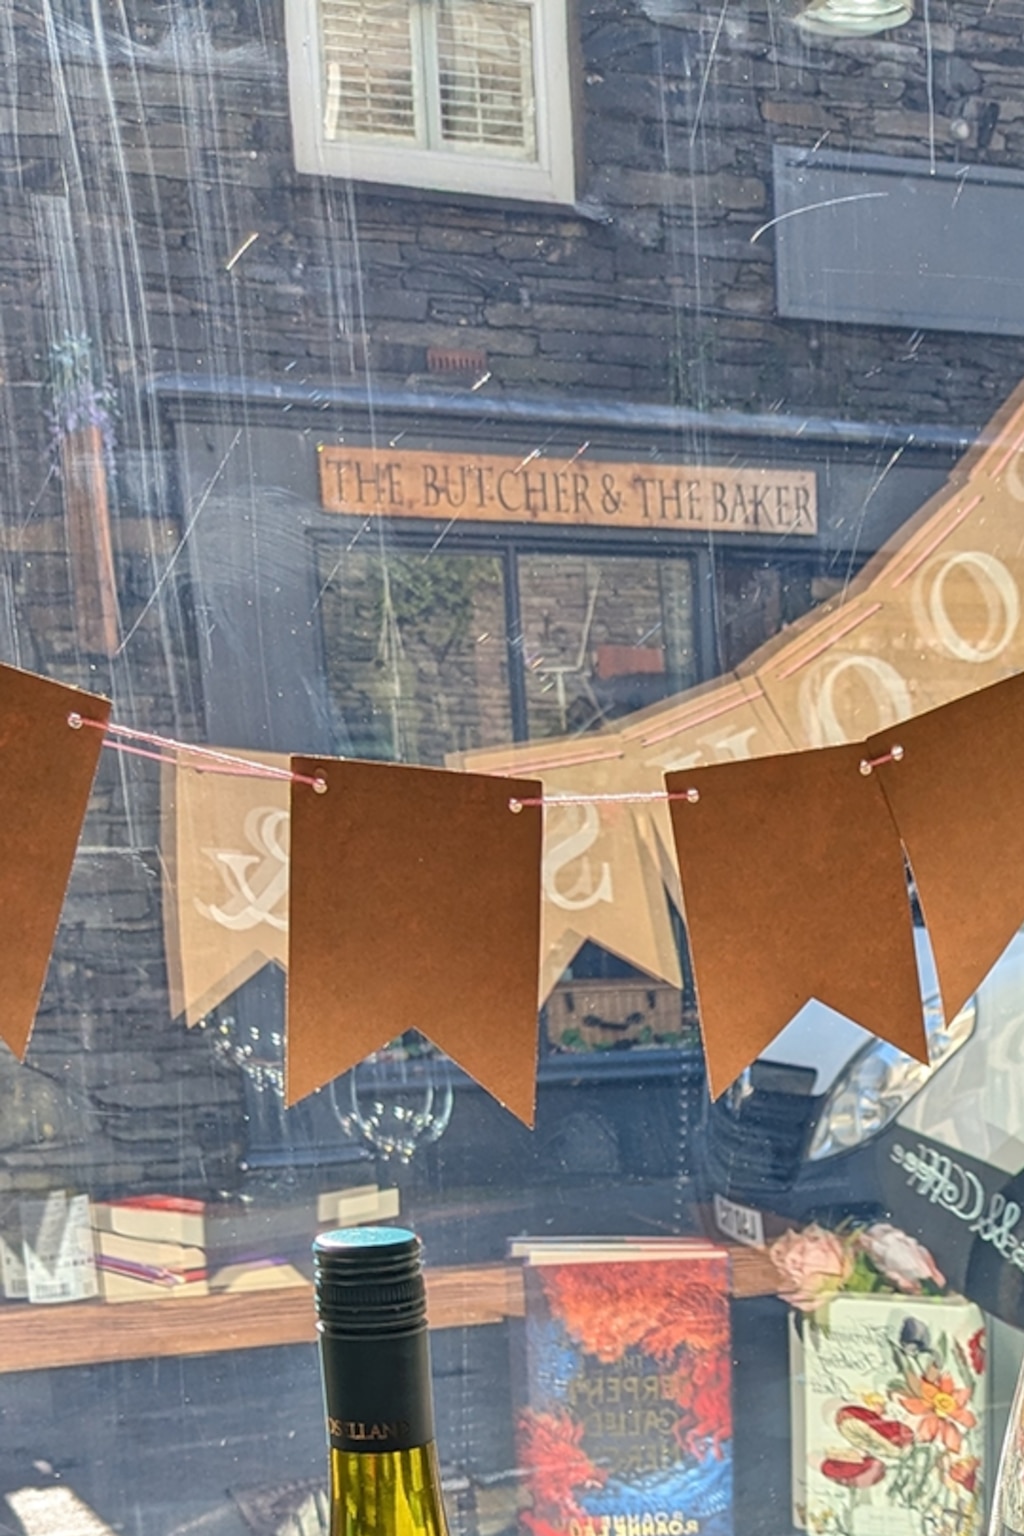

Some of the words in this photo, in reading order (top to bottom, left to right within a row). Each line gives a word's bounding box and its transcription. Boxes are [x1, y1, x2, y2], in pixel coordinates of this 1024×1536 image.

[325, 458, 402, 504] THE
[423, 464, 594, 515] BUTCHER
[601, 473, 624, 515] &
[637, 477, 702, 521] THE
[712, 482, 815, 528] BAKER
